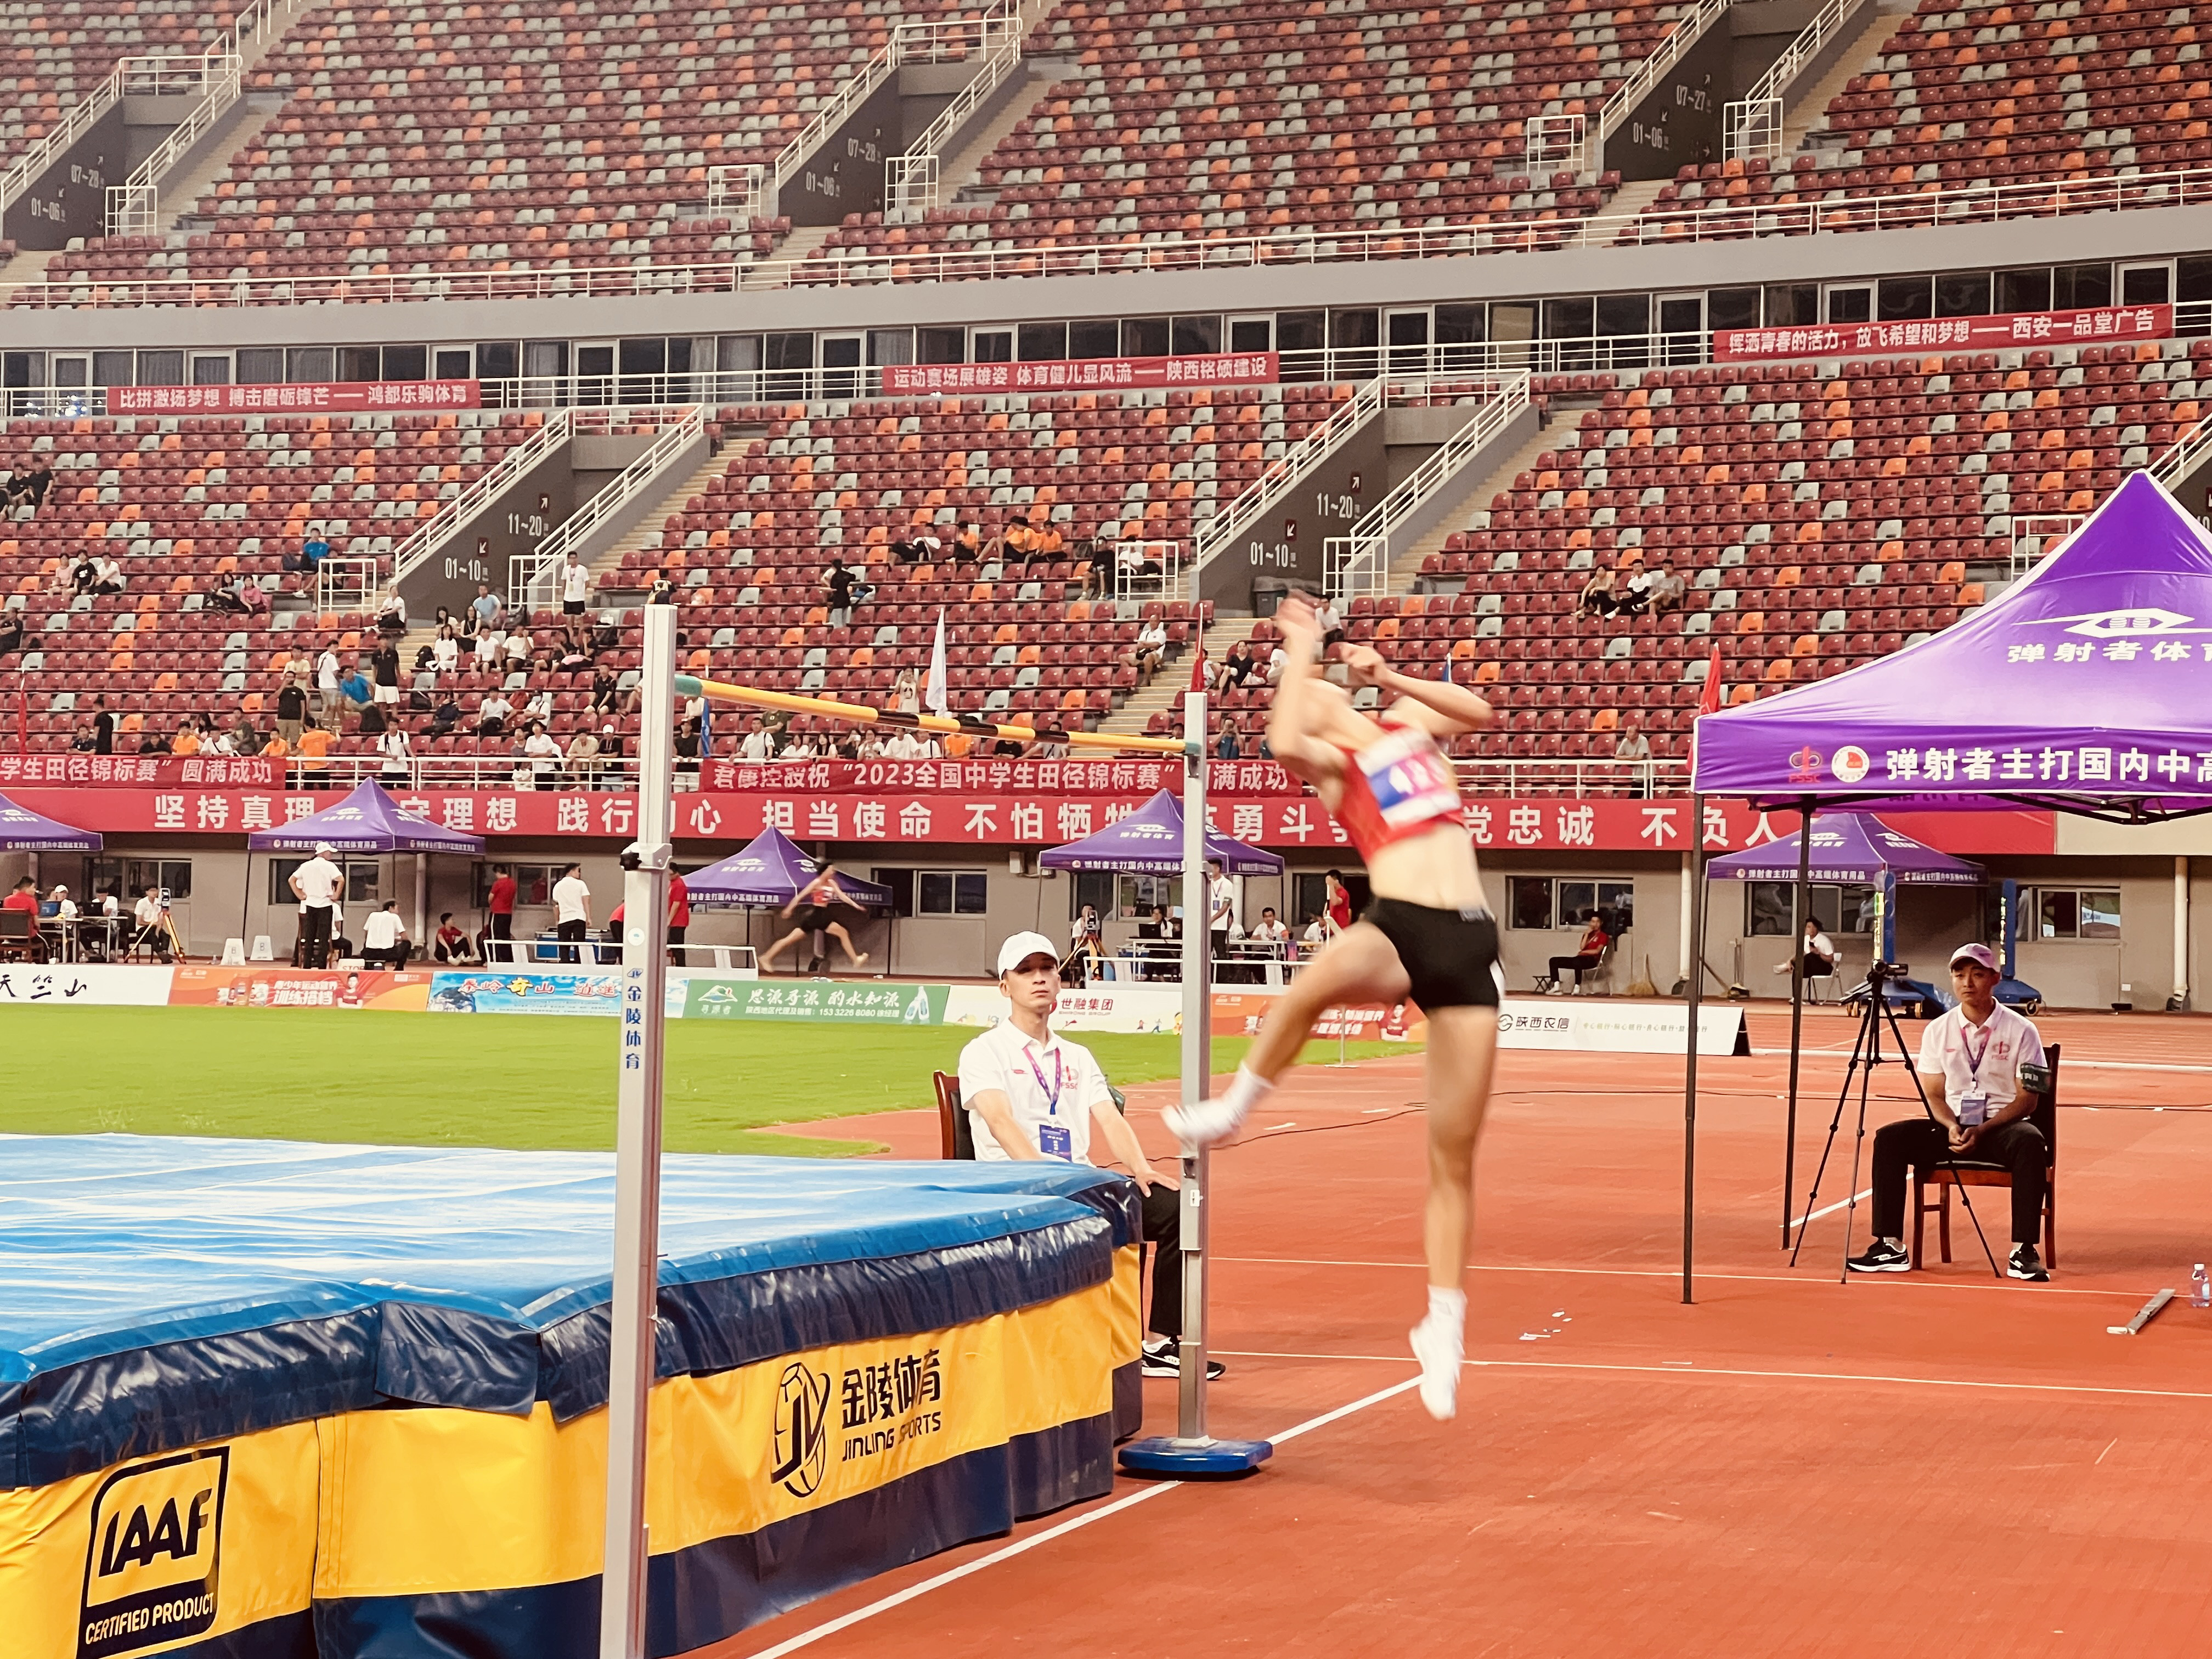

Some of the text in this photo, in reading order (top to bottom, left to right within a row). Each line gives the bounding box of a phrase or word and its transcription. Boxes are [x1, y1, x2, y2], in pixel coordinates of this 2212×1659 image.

[1633, 122, 1662, 149] 01~06
[1317, 493, 1353, 518] 11~20
[508, 512, 542, 537] 11~20
[1250, 541, 1288, 567] 01~10
[445, 557, 481, 581] 01~10
[154, 794, 315, 830] 坚持真理
[400, 795, 518, 832] 守理想
[557, 797, 721, 834] 践行心
[762, 799, 932, 839] 担当使命
[1206, 804, 1347, 843] 勇斗
[1463, 805, 1594, 846] 党忠诚
[1640, 806, 1779, 847] 不负人
[1061, 998, 1113, 1011] 世融集团
[626, 986, 642, 1069] 金陵体育
[1516, 1017, 1570, 1030] 陕西农信
[842, 1348, 941, 1430] 金陵体育
[842, 1411, 942, 1462] JINLING SPORTS
[98, 1488, 213, 1578] IAAF
[86, 1592, 215, 1645] CERTIFIED PRODUCT
